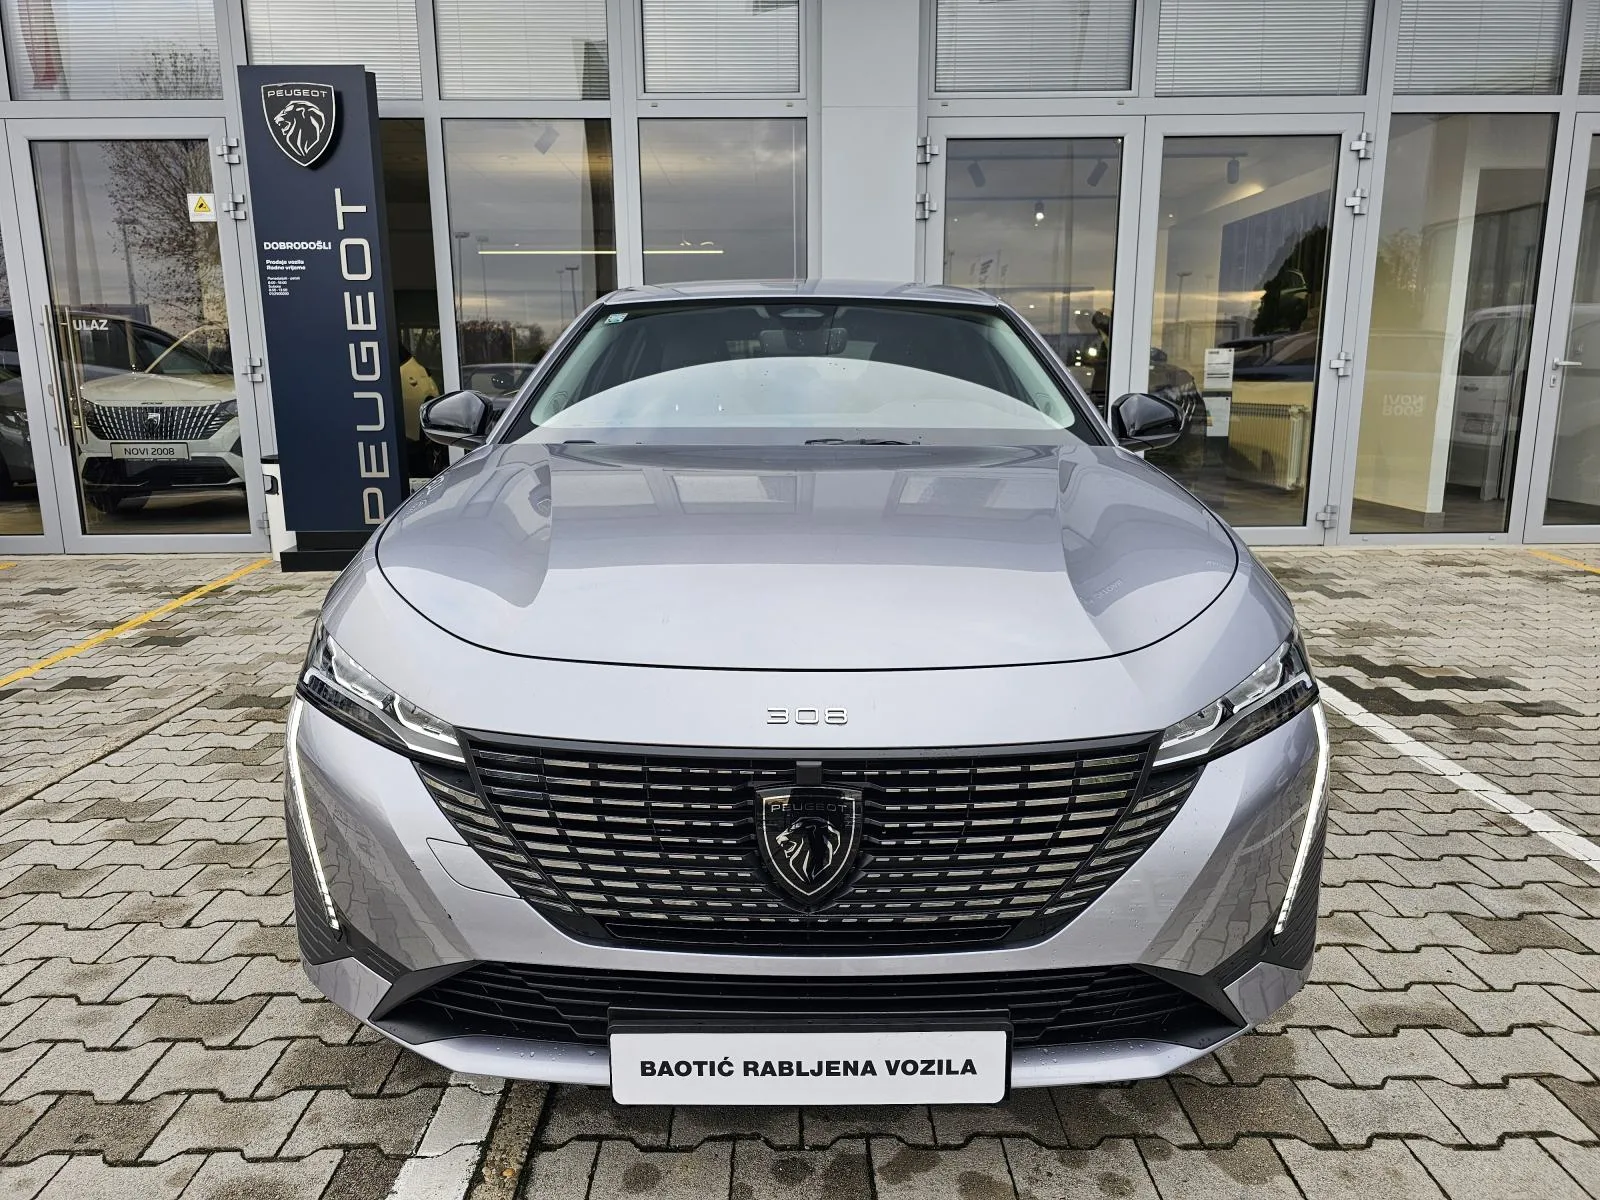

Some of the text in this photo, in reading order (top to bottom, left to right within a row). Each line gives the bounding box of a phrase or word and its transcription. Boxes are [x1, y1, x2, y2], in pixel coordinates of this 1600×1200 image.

[267, 89, 328, 98] PEUGEOT
[263, 240, 332, 250] DOBRODOŠLI
[72, 319, 109, 331] ULAZ
[334, 187, 390, 525] PEUGEOT
[124, 447, 175, 456] NOVI 2008
[766, 707, 848, 725] 308
[770, 803, 848, 813] PEUGEOT
[640, 1056, 978, 1077] BAOTIĆ RABLJENA VOZILA
